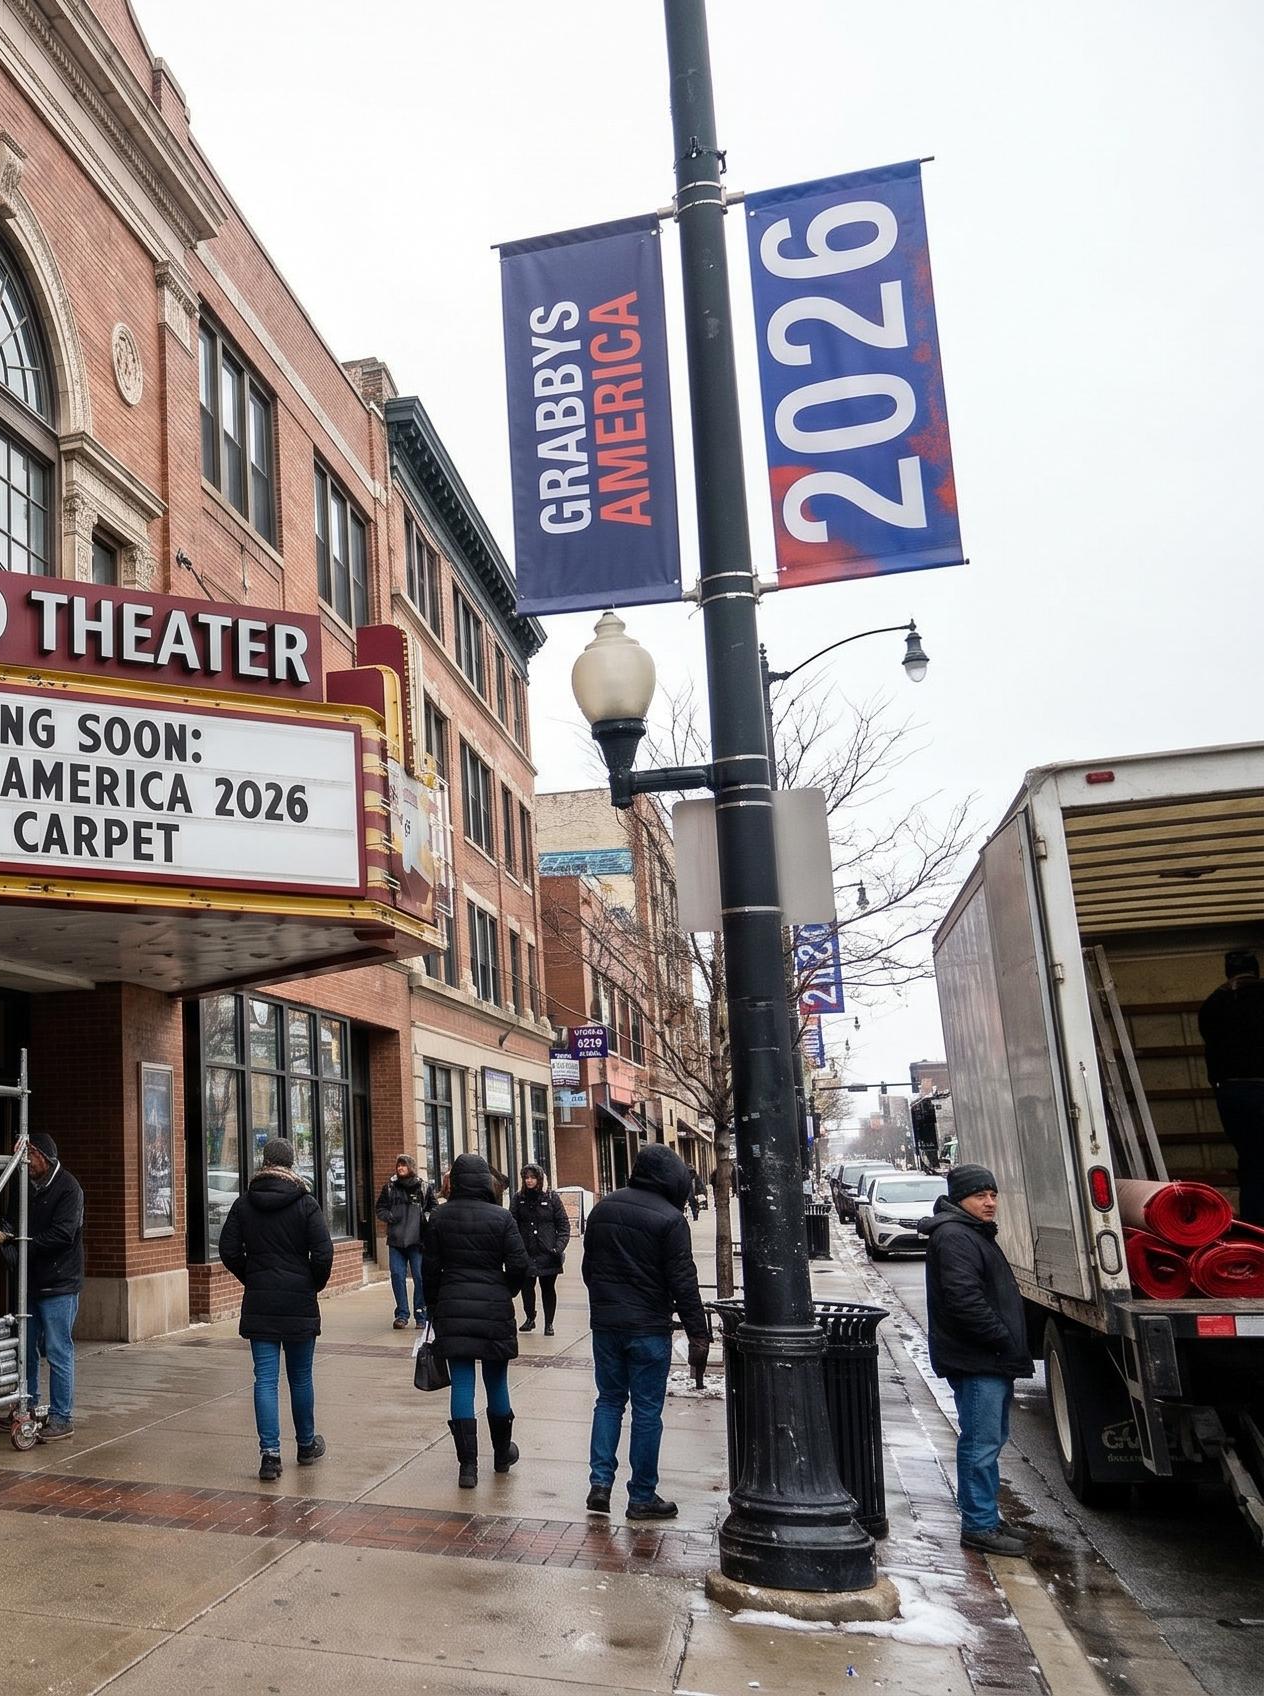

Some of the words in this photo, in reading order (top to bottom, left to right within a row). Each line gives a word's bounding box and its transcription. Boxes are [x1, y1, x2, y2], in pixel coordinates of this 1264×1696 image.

[529, 300, 592, 535] GRABBYS
[588, 291, 652, 526] AMERICA
[759, 200, 928, 543] 2026
[30, 590, 310, 684] THEATER
[77, 713, 202, 763] SOON:
[0, 757, 192, 813] AMERICA
[215, 777, 309, 823] 2026
[14, 811, 179, 863] CARPET
